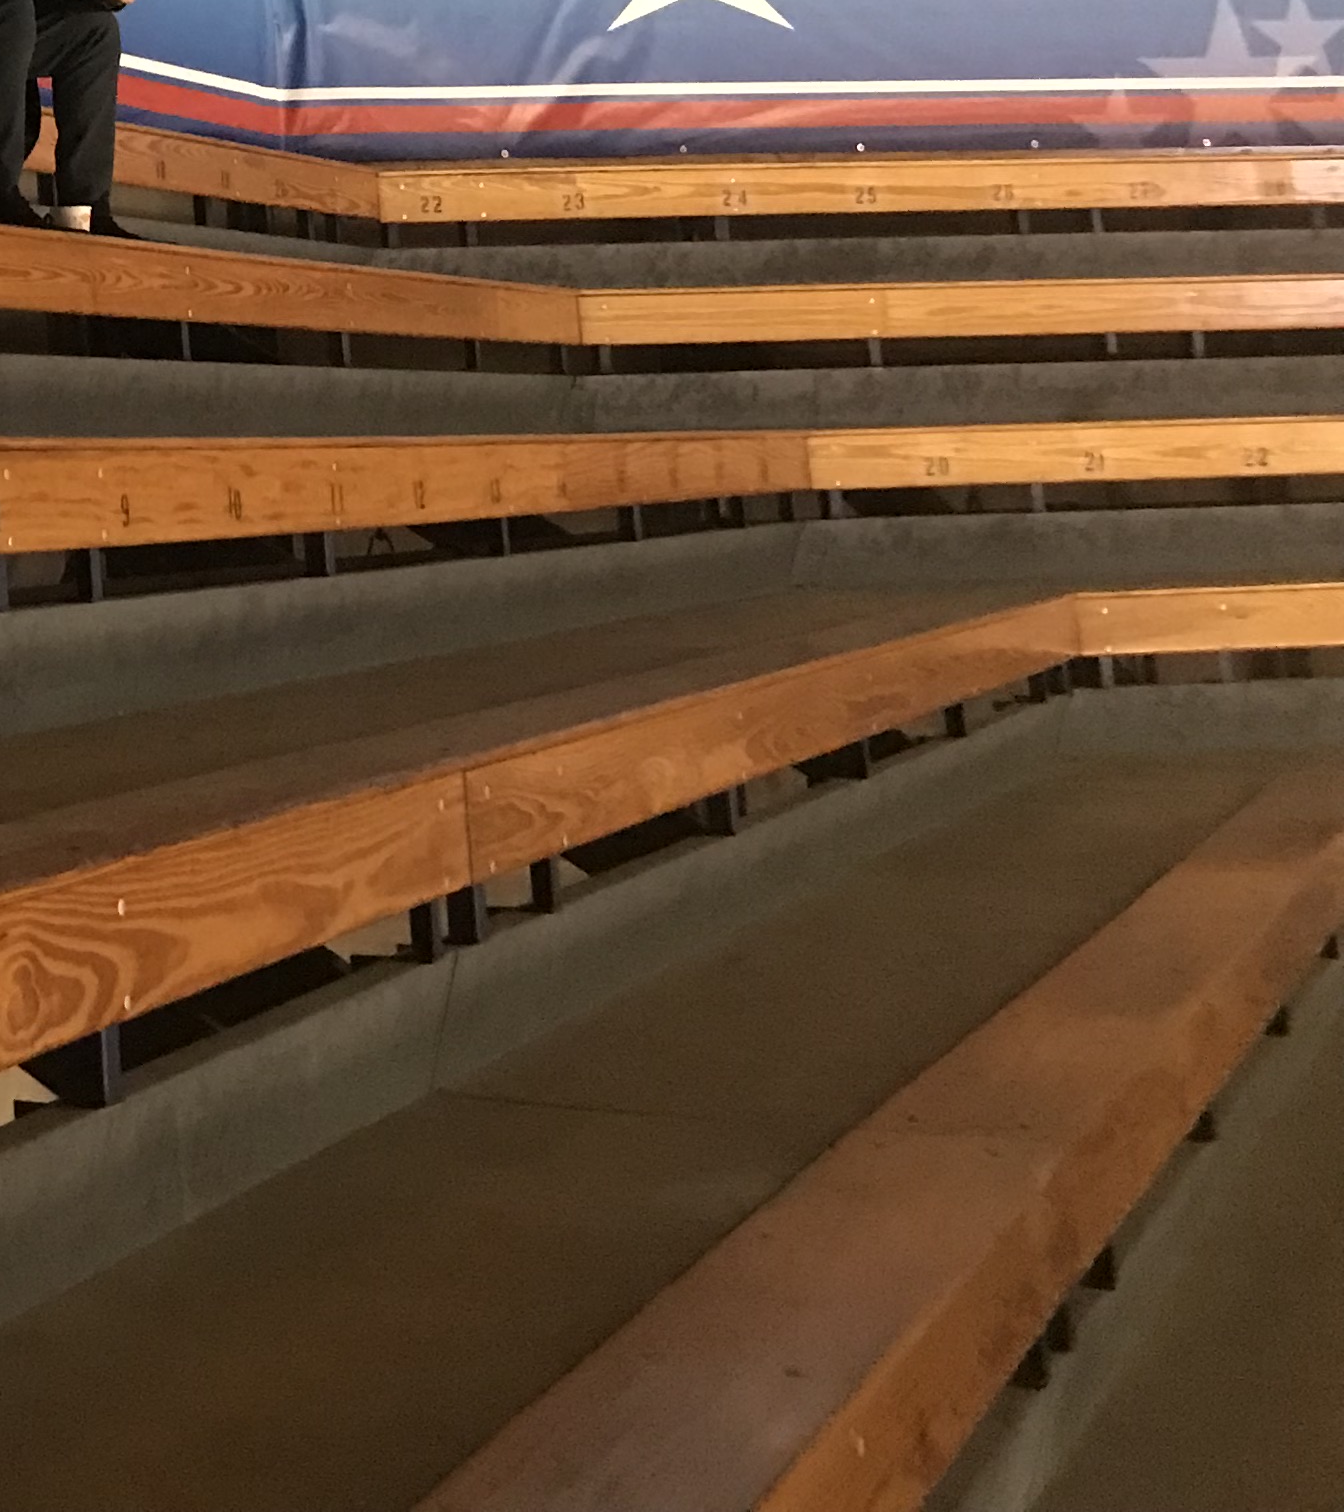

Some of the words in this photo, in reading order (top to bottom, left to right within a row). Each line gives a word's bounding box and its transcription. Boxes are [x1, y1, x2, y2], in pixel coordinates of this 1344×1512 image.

[420, 195, 444, 214] 22
[562, 192, 586, 212] 23
[722, 188, 748, 208] 24
[120, 493, 130, 528] 9
